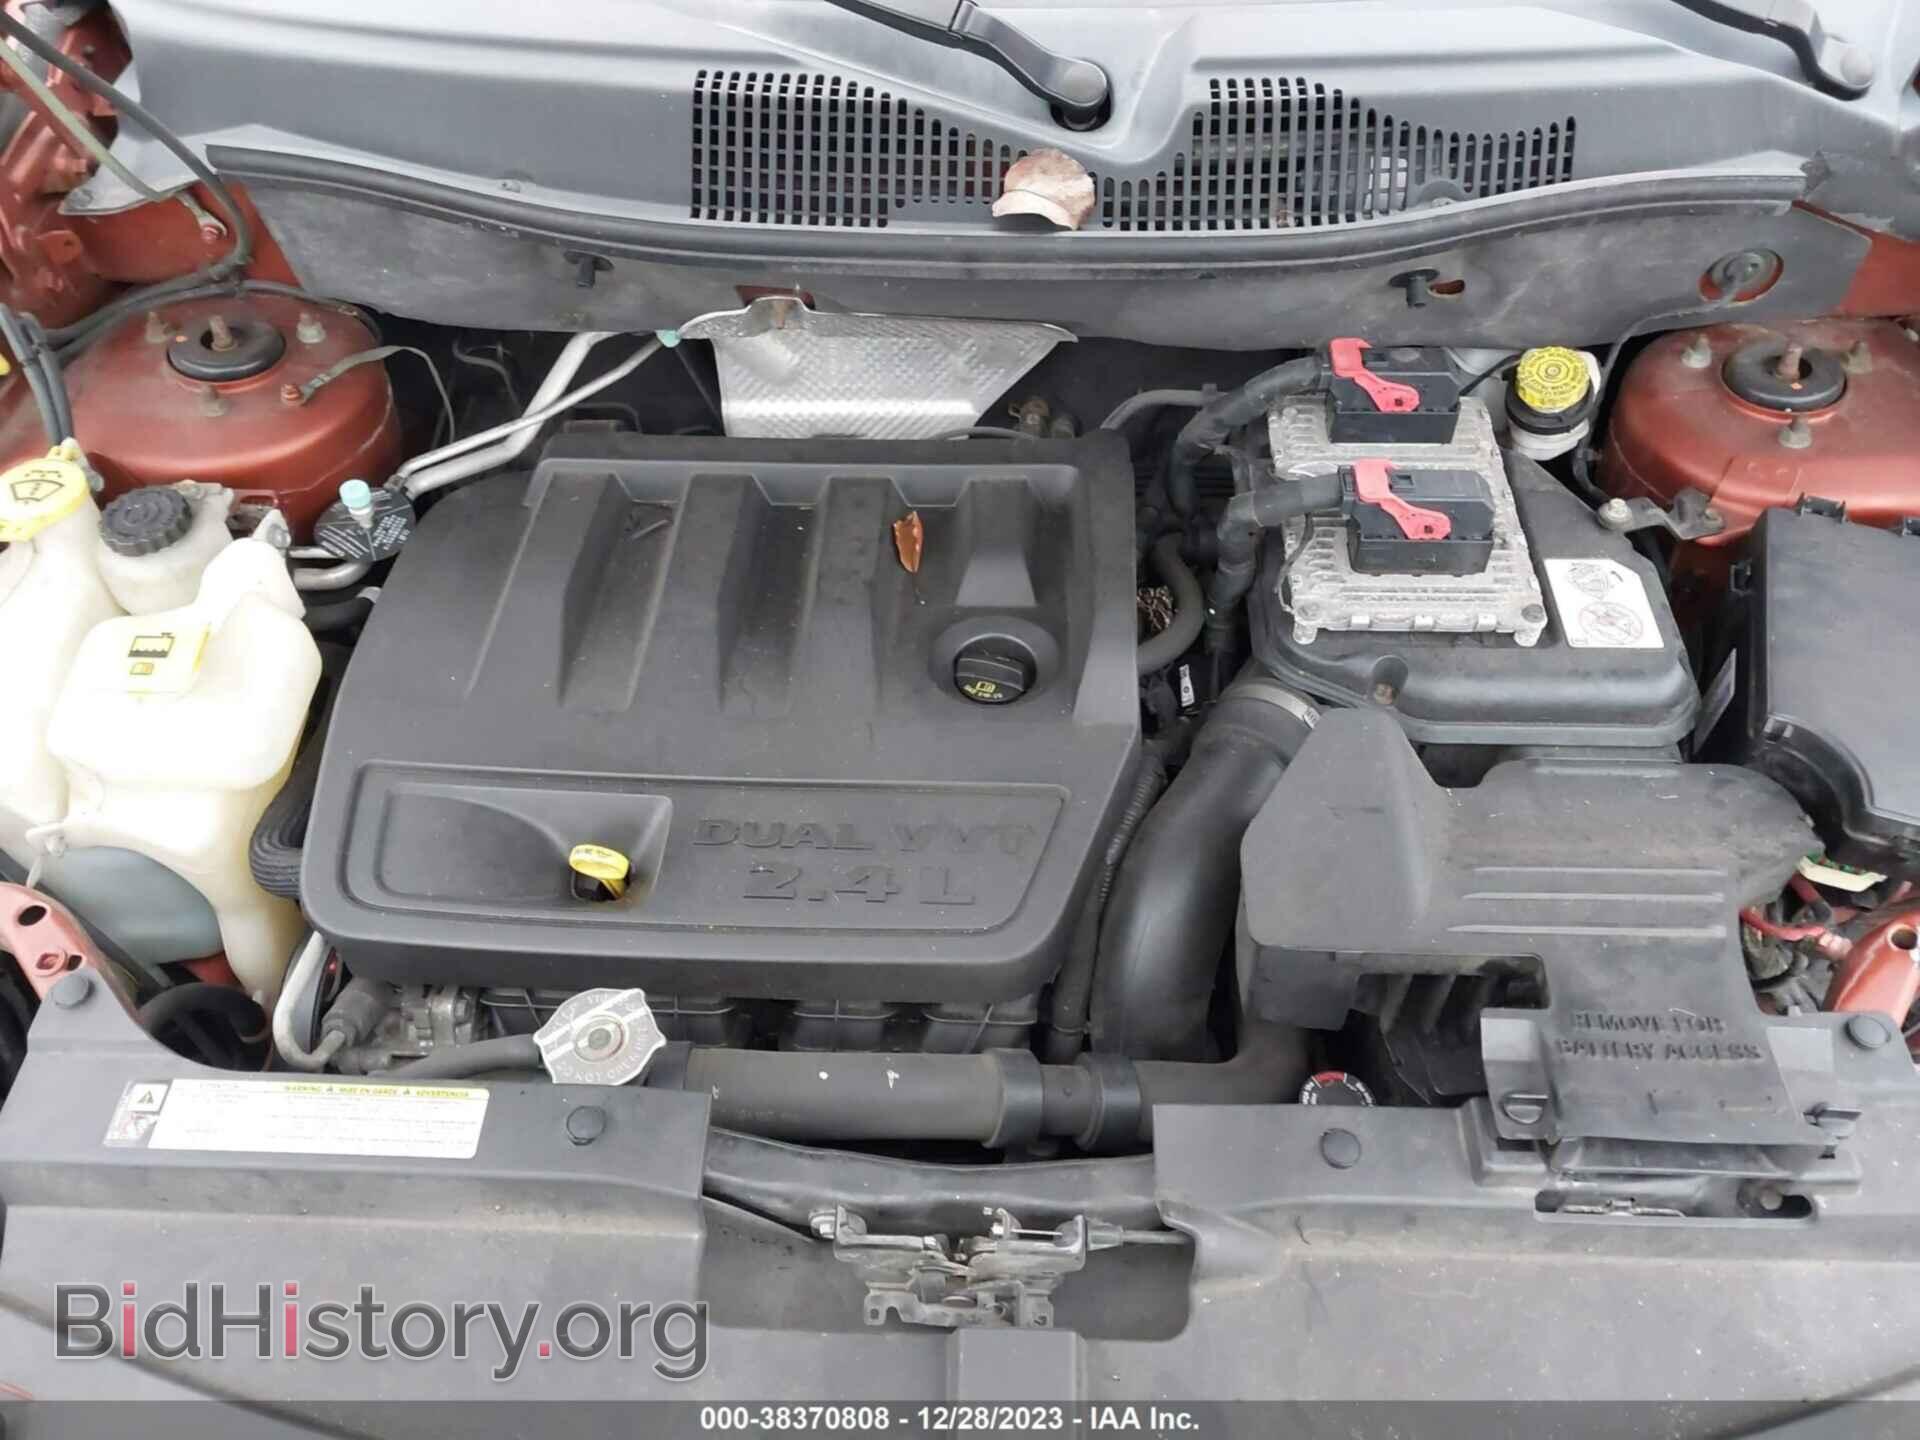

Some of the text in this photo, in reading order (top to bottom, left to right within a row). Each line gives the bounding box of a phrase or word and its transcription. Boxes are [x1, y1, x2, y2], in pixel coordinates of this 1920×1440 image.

[693, 818, 873, 850] DUAL
[1571, 1012, 1726, 1034] REMOVE FOR
[1555, 1037, 1764, 1061] BATTERY ACCESS
